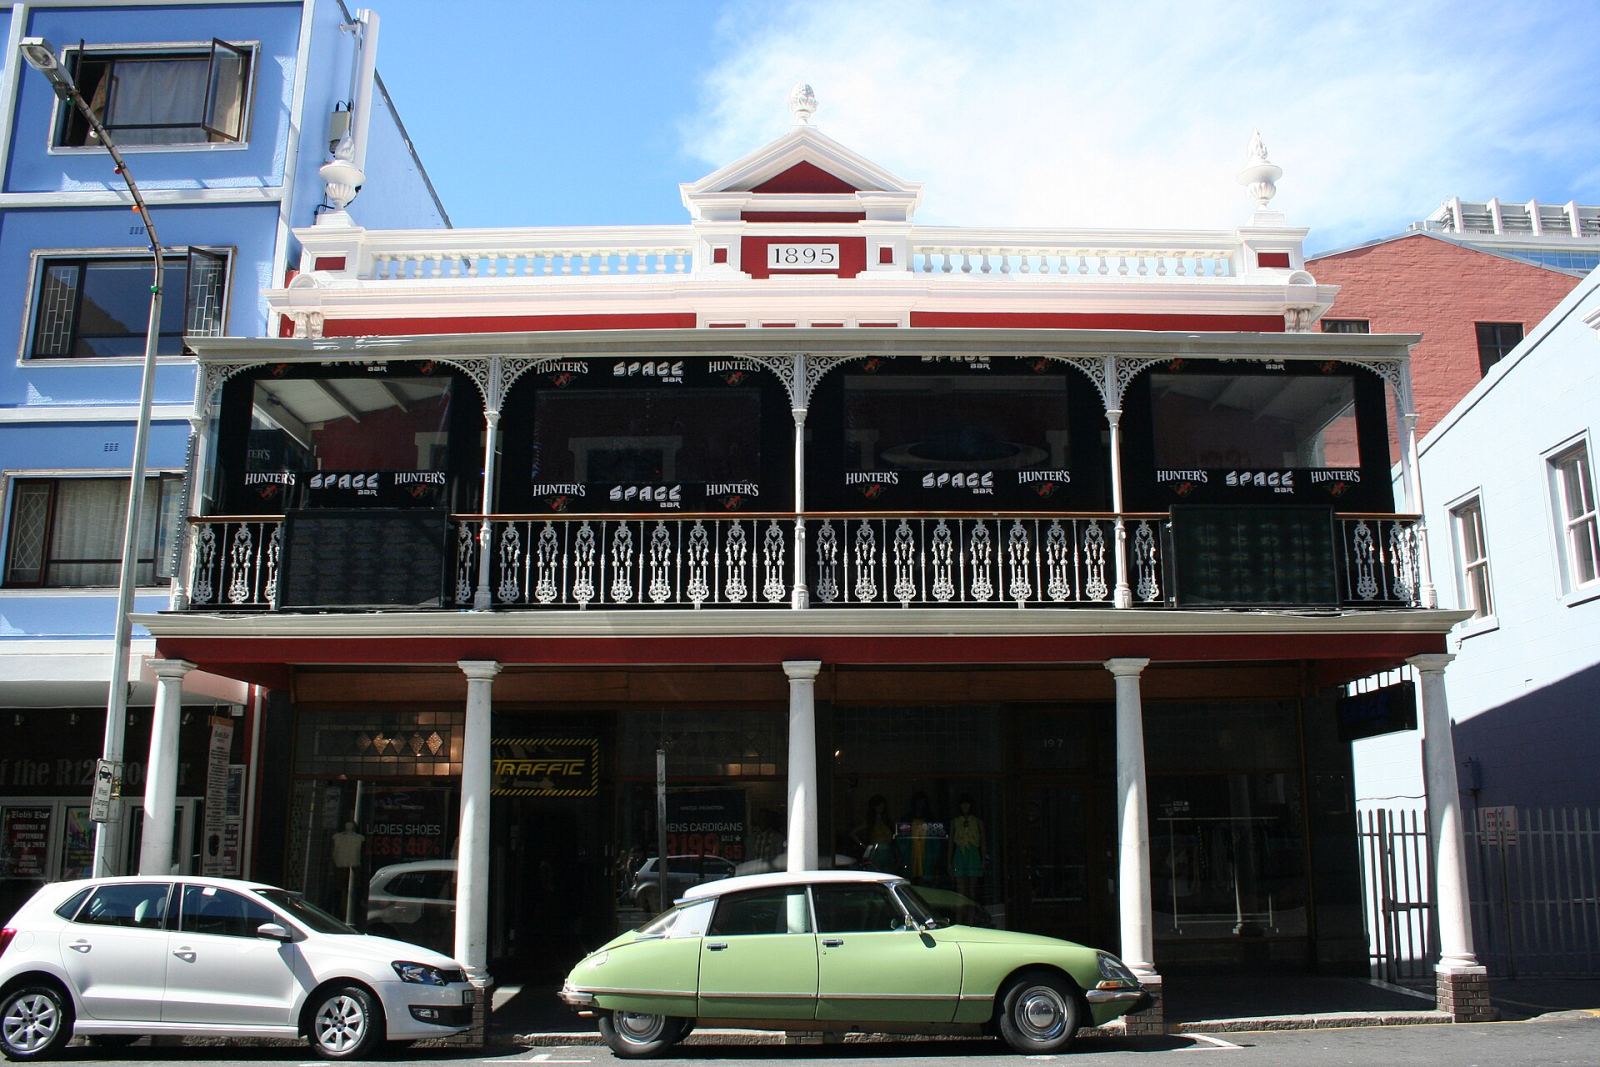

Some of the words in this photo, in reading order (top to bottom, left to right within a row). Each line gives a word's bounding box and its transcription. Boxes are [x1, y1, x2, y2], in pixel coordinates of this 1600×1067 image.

[775, 247, 834, 264] 1895
[536, 360, 589, 374] HUNTER'S
[612, 361, 684, 377] SPACE
[708, 359, 762, 374] HUNTER'S
[244, 471, 296, 486] HUNTER'S
[309, 472, 379, 489] SPACE
[394, 471, 446, 485] HUNTER'S
[845, 471, 899, 486] HUNTER'S
[922, 471, 994, 489] SPACE
[1018, 469, 1071, 484] HUNTER'S
[1156, 469, 1208, 483] HUNTER'S
[1225, 470, 1294, 487] SPACE
[1311, 469, 1361, 483] HUNTER'S
[533, 482, 586, 497] HUNTER'S
[609, 484, 682, 502] SPACE
[706, 482, 759, 497] HUNTER'S
[14, 759, 50, 785] the
[493, 759, 585, 776] TRAFFIC
[366, 823, 403, 835] LADIES
[405, 823, 441, 836] SHOES
[690, 822, 743, 832] CARDIGANS
